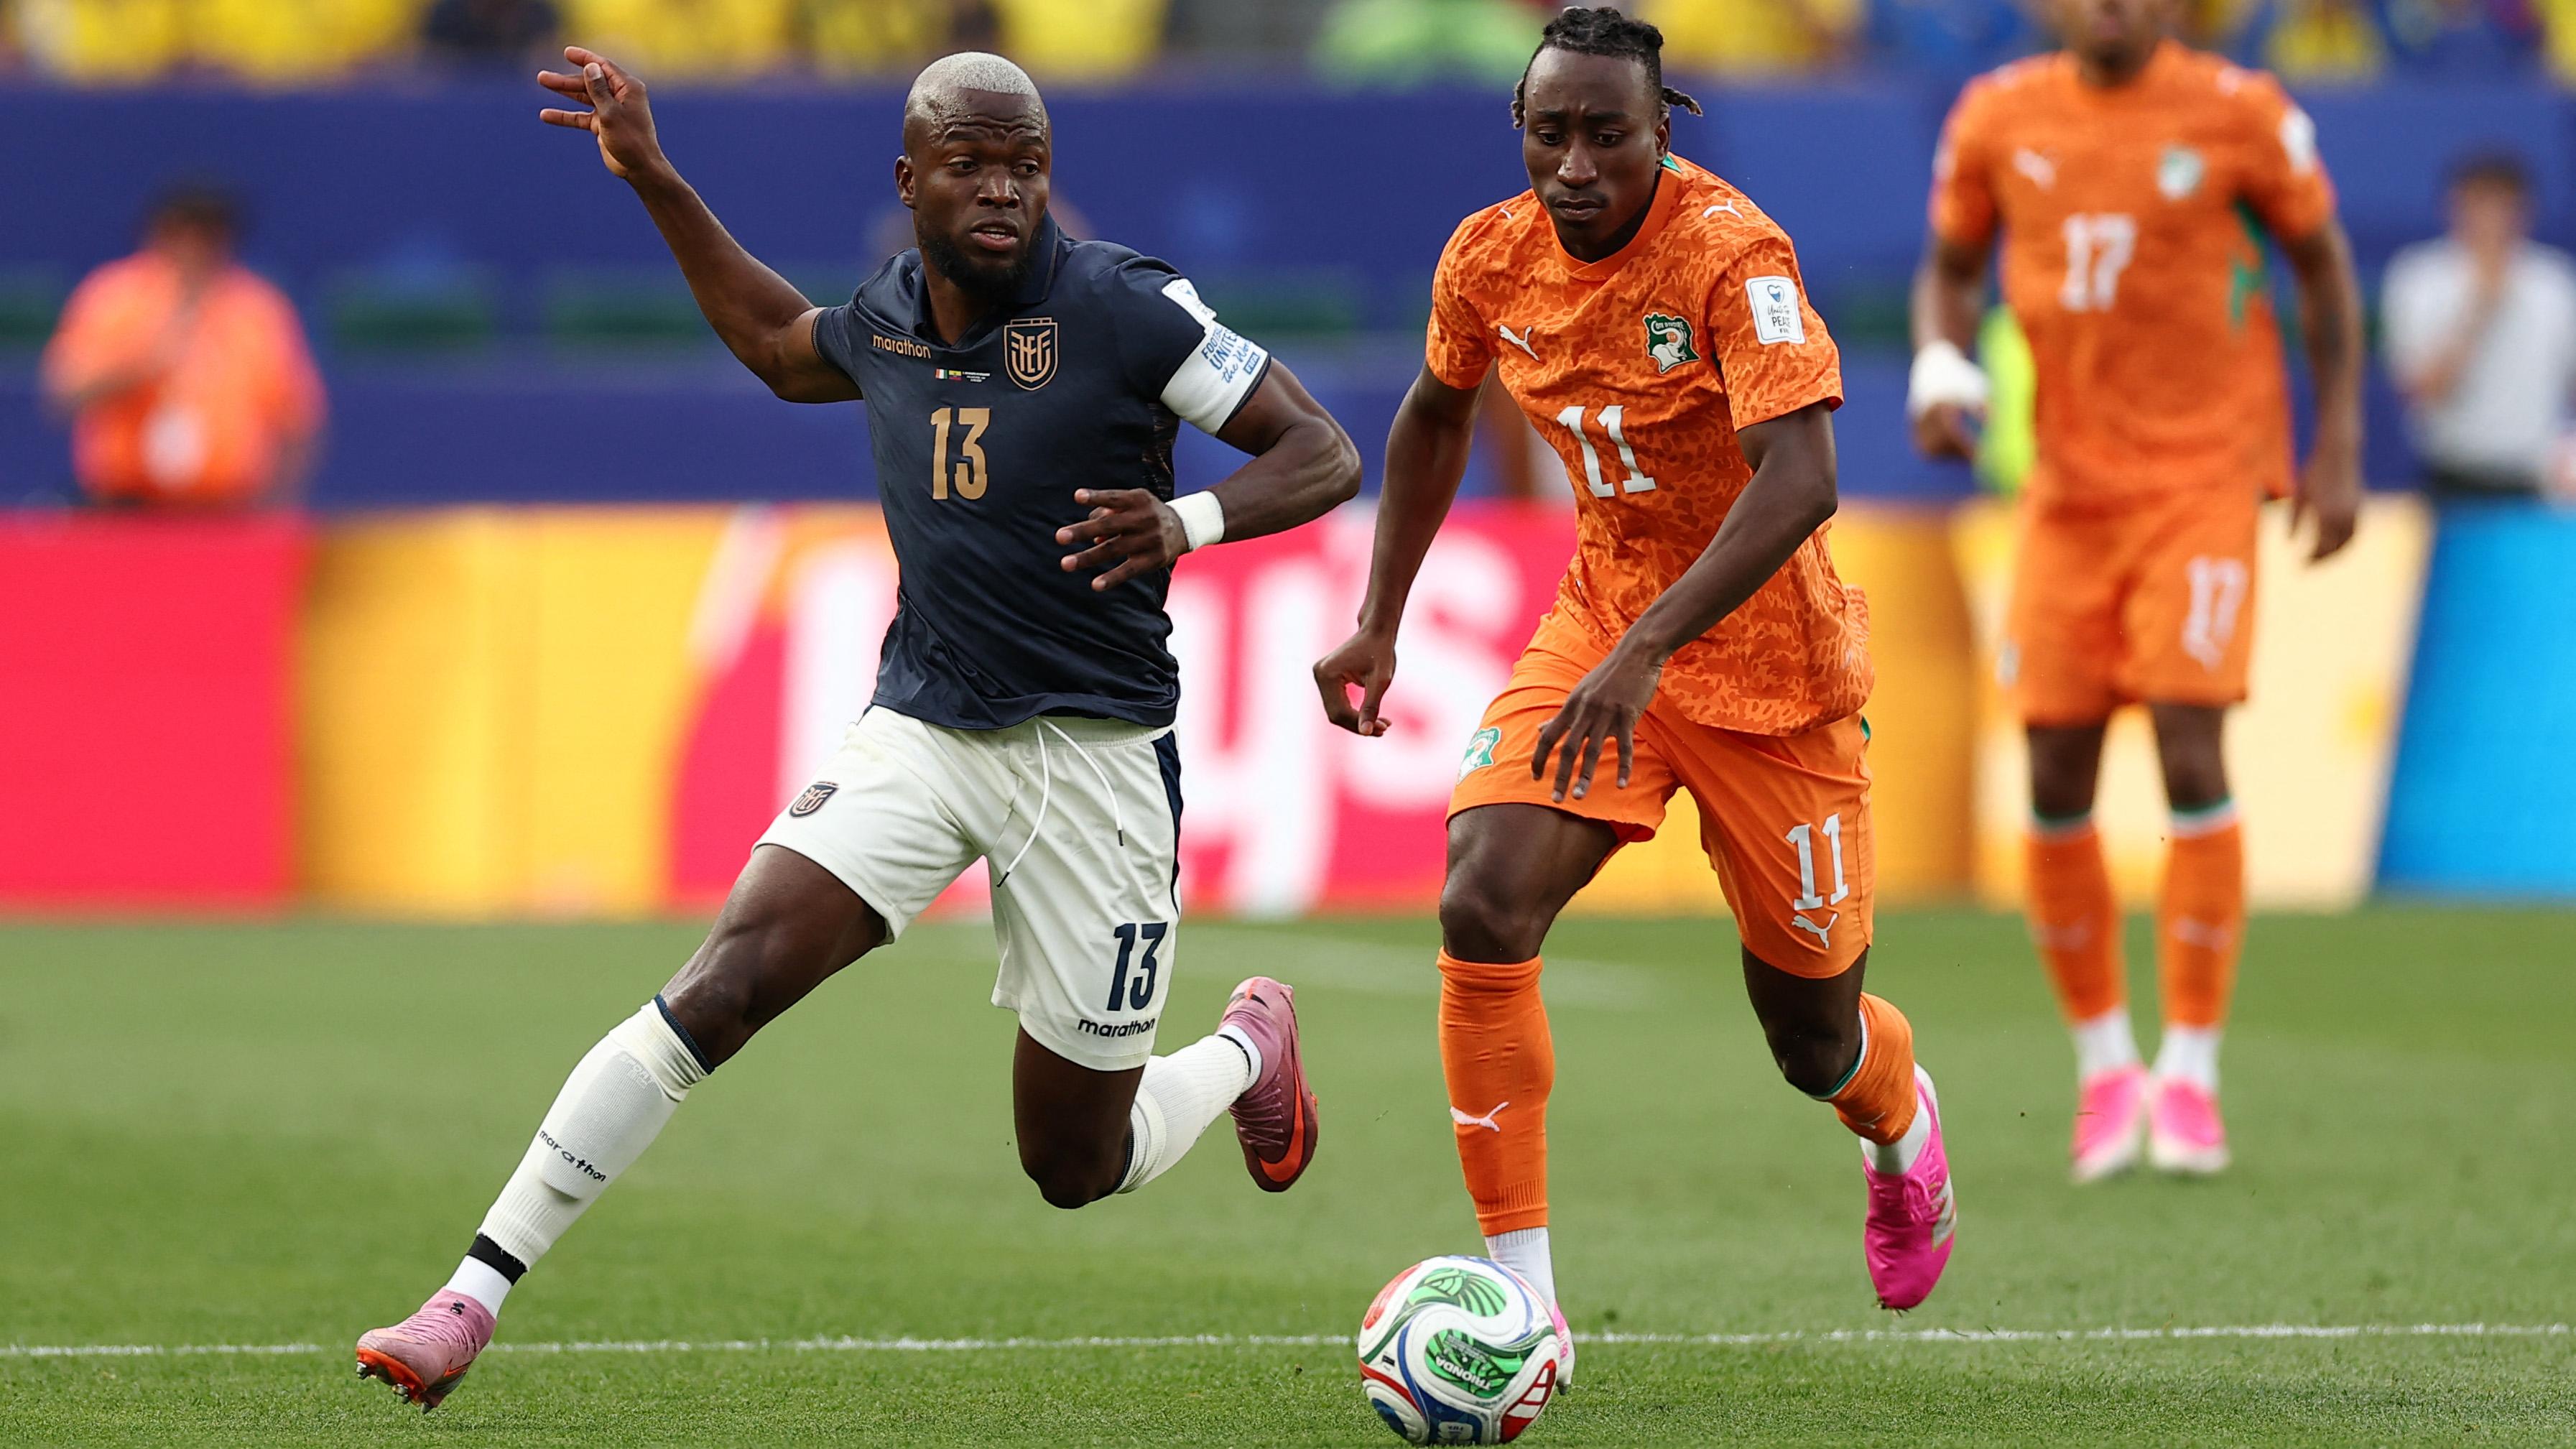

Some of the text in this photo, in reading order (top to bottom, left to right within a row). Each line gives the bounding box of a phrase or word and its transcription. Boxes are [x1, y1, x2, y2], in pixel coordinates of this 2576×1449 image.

[2059, 213, 2136, 312] 17
[873, 334, 932, 359] marathon
[930, 407, 991, 500] 13
[1556, 405, 1657, 497] 11
[2182, 555, 2249, 673] 17
[1785, 813, 1849, 911] 11
[1107, 922, 1168, 1011] 13
[1078, 1018, 1155, 1037] marathon
[539, 1130, 606, 1182] marathon
[1435, 1356, 1491, 1391] TRIONDA
